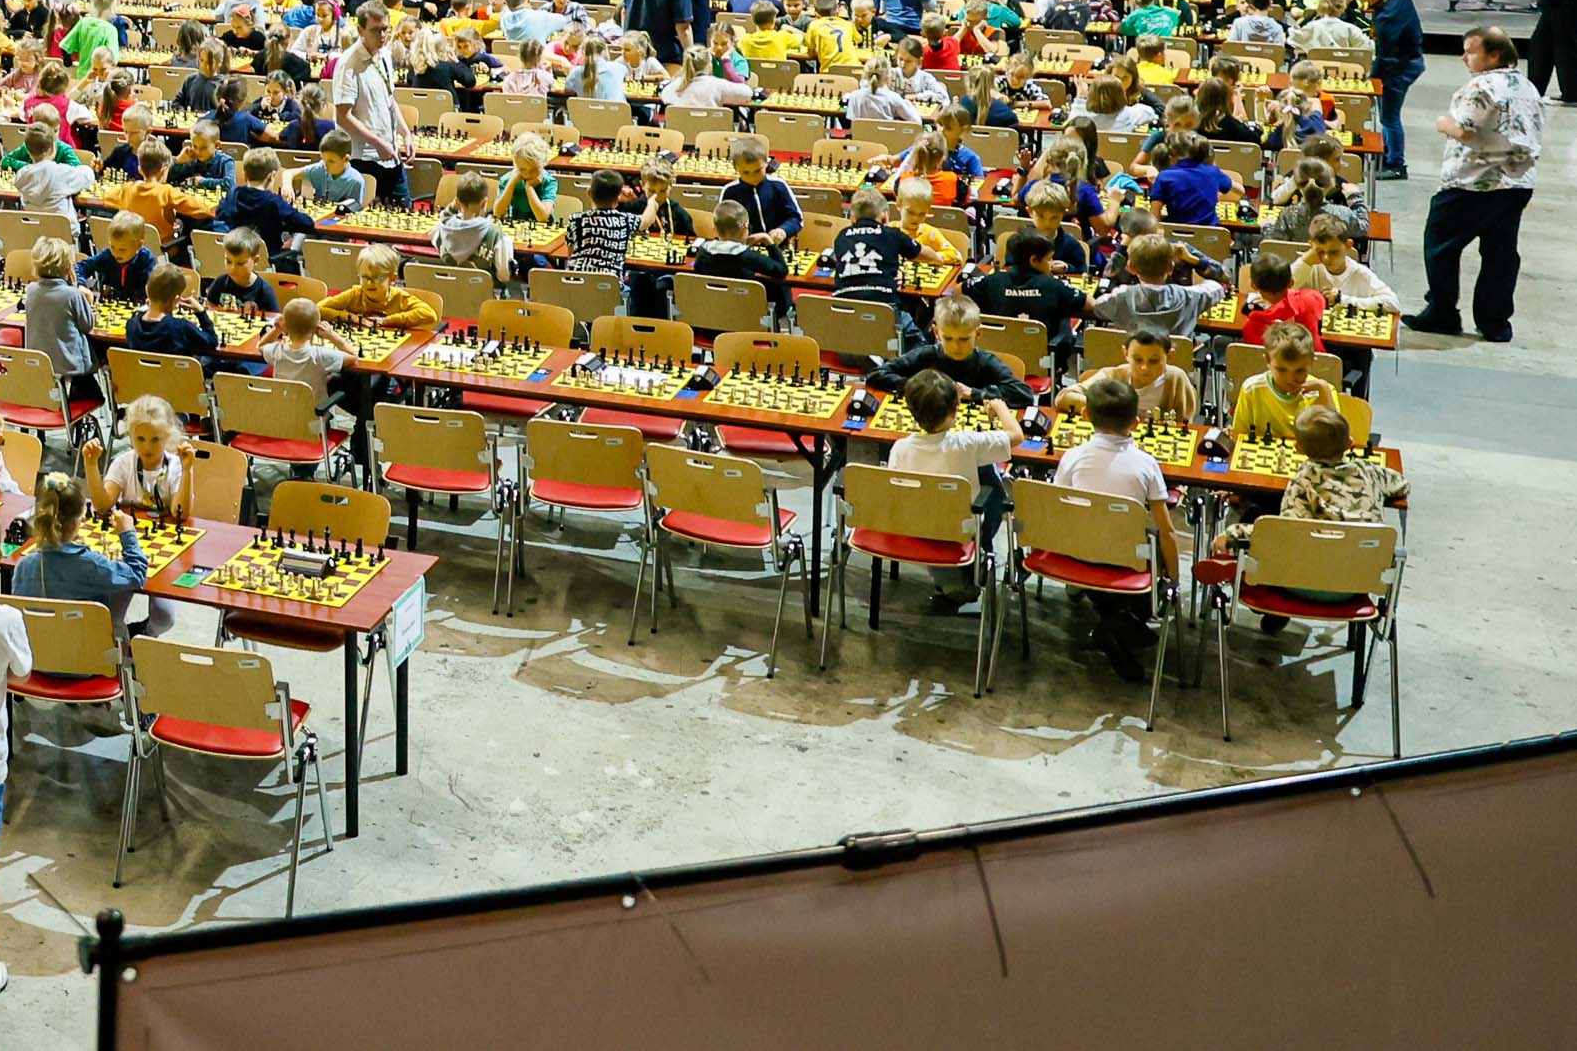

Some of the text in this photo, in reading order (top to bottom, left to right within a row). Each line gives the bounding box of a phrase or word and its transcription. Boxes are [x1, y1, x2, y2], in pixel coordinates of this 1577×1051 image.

[830, 29, 844, 53] 7
[581, 216, 627, 228] FUTURE
[582, 227, 628, 239] FUTURE
[846, 225, 883, 236] ANTOŚ
[581, 237, 626, 250] FUTURE
[1004, 288, 1042, 297] DANIEL
